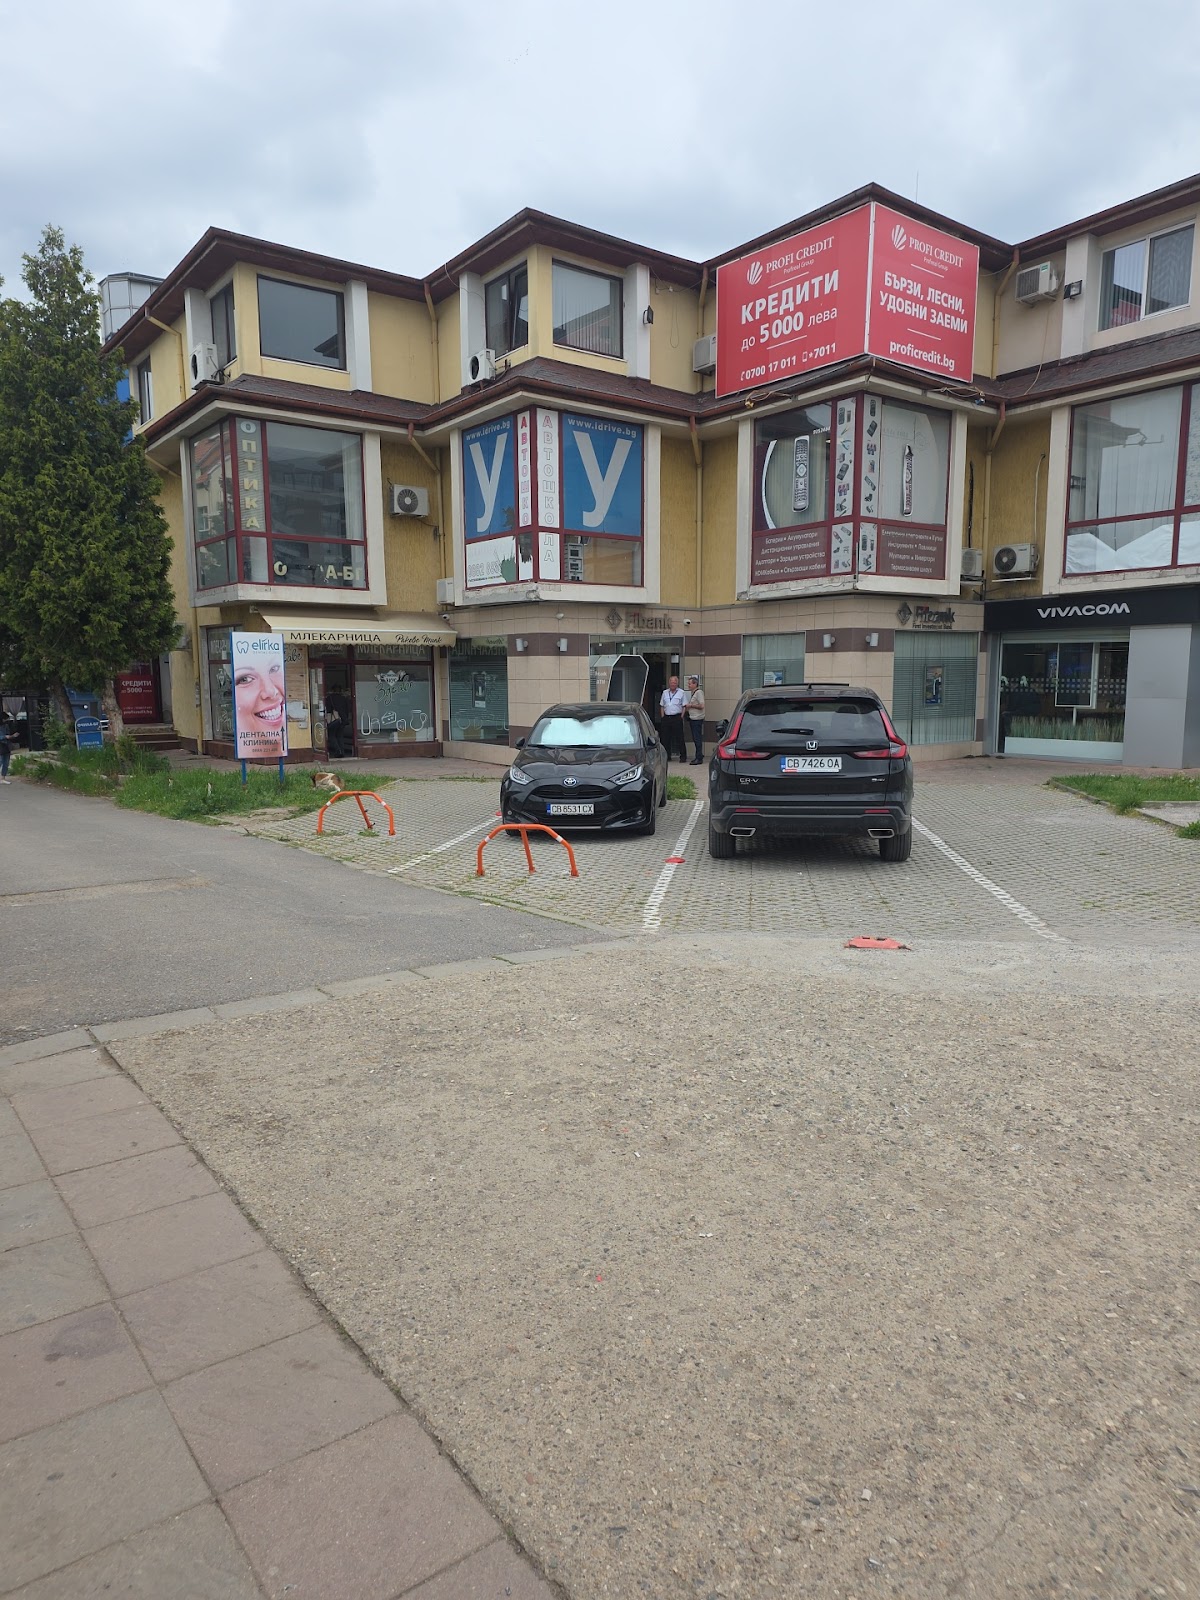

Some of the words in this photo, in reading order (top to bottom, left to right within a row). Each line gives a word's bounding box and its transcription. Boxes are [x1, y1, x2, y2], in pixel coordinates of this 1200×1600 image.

[766, 252, 794, 274] PROFI
[795, 236, 835, 262] CREDIT
[909, 236, 933, 256] PROFI
[934, 247, 964, 268] CREDIT
[741, 269, 839, 325] КРЕДИТИ
[884, 271, 924, 301] БЪРЗИ,
[926, 287, 965, 315] ЛЕСНИ,
[879, 290, 927, 321] УДОБНИ
[930, 308, 968, 334] ЗАЕМИ
[741, 336, 756, 352] до
[808, 307, 838, 328] лева
[745, 365, 766, 380] 0700
[768, 360, 779, 373] 17
[780, 355, 797, 369] 011
[889, 341, 955, 372] proficredit.bg
[465, 420, 511, 441] www.idrive.bg
[567, 417, 637, 438] www.idrive.bg
[240, 421, 261, 529] ОПТИКА
[625, 611, 672, 630] Fibank
[1037, 602, 1131, 619] VIVACOM
[290, 632, 381, 643] МЛЕКАРНИЦА
[239, 731, 280, 739] ДЕНТАЛНА
[243, 739, 279, 747] КЛИНИКА
[787, 758, 800, 769] CB
[801, 758, 826, 769] 7426
[563, 805, 581, 814] 8531
